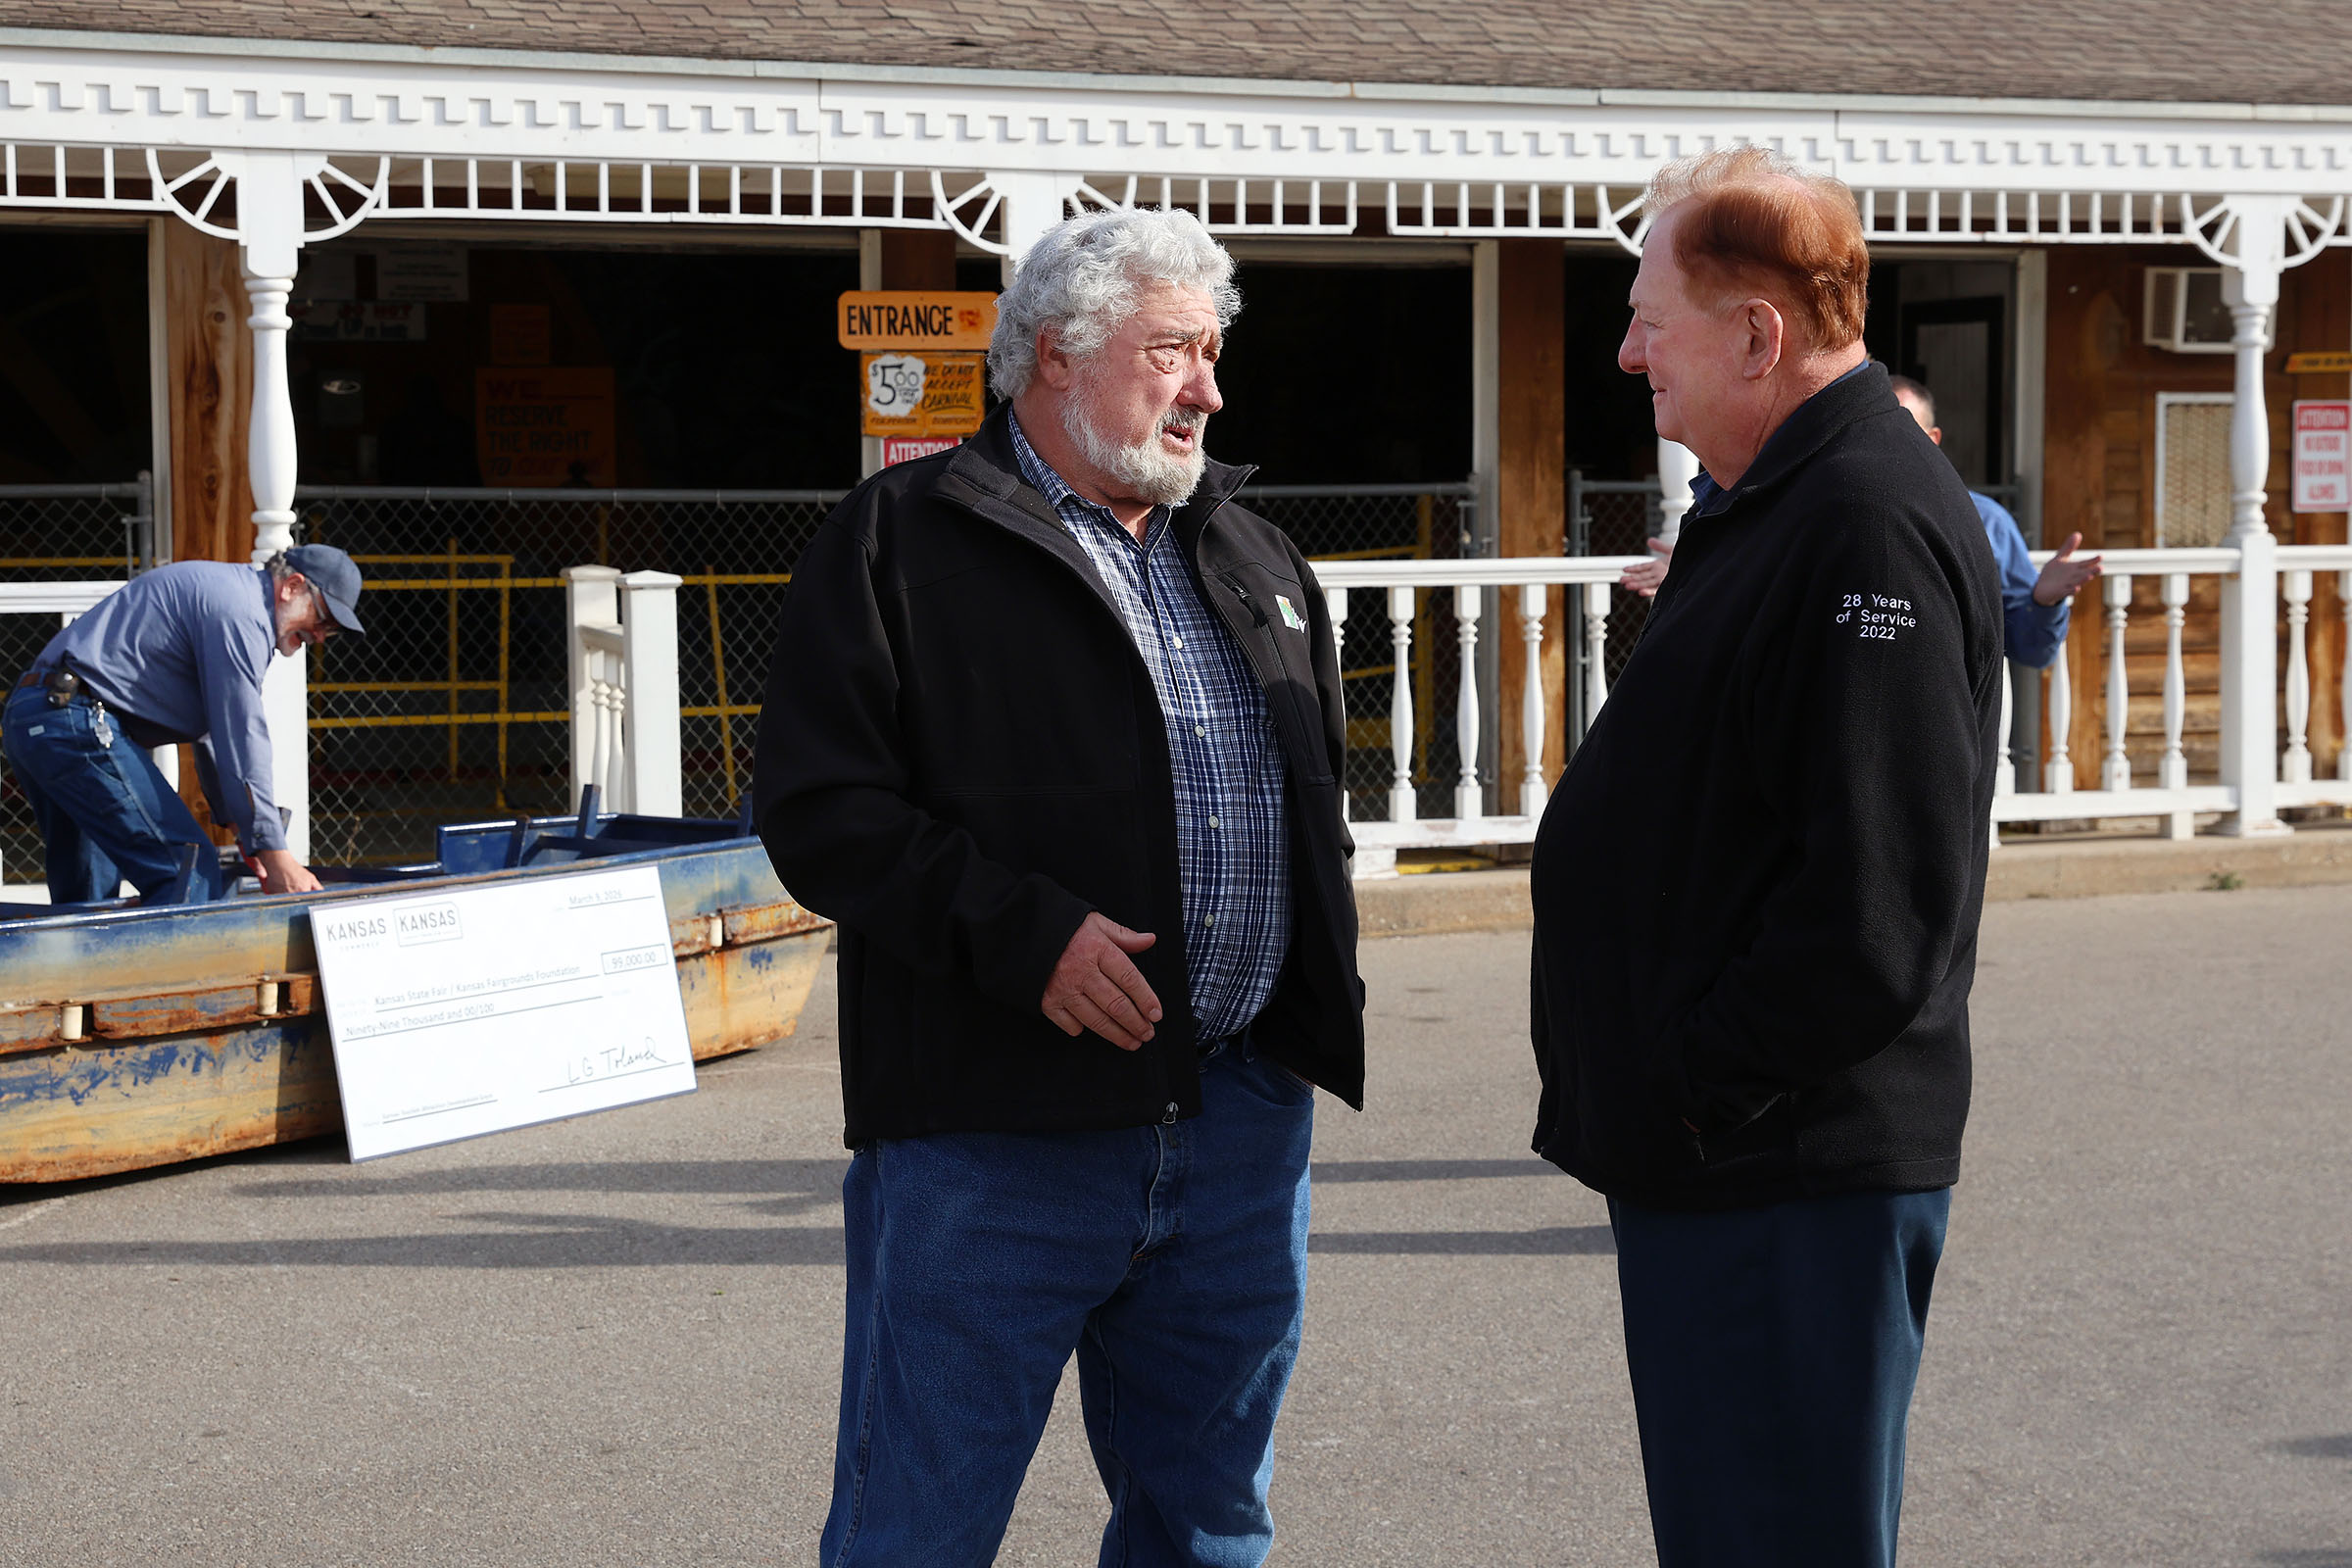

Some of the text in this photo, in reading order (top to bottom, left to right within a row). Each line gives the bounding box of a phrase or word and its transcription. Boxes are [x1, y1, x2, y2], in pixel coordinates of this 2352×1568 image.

[847, 305, 954, 336] ENTRANCE
[486, 404, 568, 427] RESERVE
[487, 430, 592, 453] THE RIGHT
[1842, 593, 1912, 612] 28 Years
[1836, 609, 1917, 628] of Service
[1859, 624, 1896, 640] 2022
[326, 918, 387, 942] KANSAS
[399, 909, 457, 933] KANSAS
[375, 992, 407, 1005] Kansas
[407, 989, 430, 1001] State
[431, 985, 449, 997] Fair
[456, 980, 485, 993] Kansas
[486, 972, 534, 989] Fairgrounds
[535, 965, 580, 980] Foundation
[345, 1018, 401, 1036] Ninety-Nine
[402, 1010, 445, 1027] Thousand
[446, 1007, 463, 1020] and
